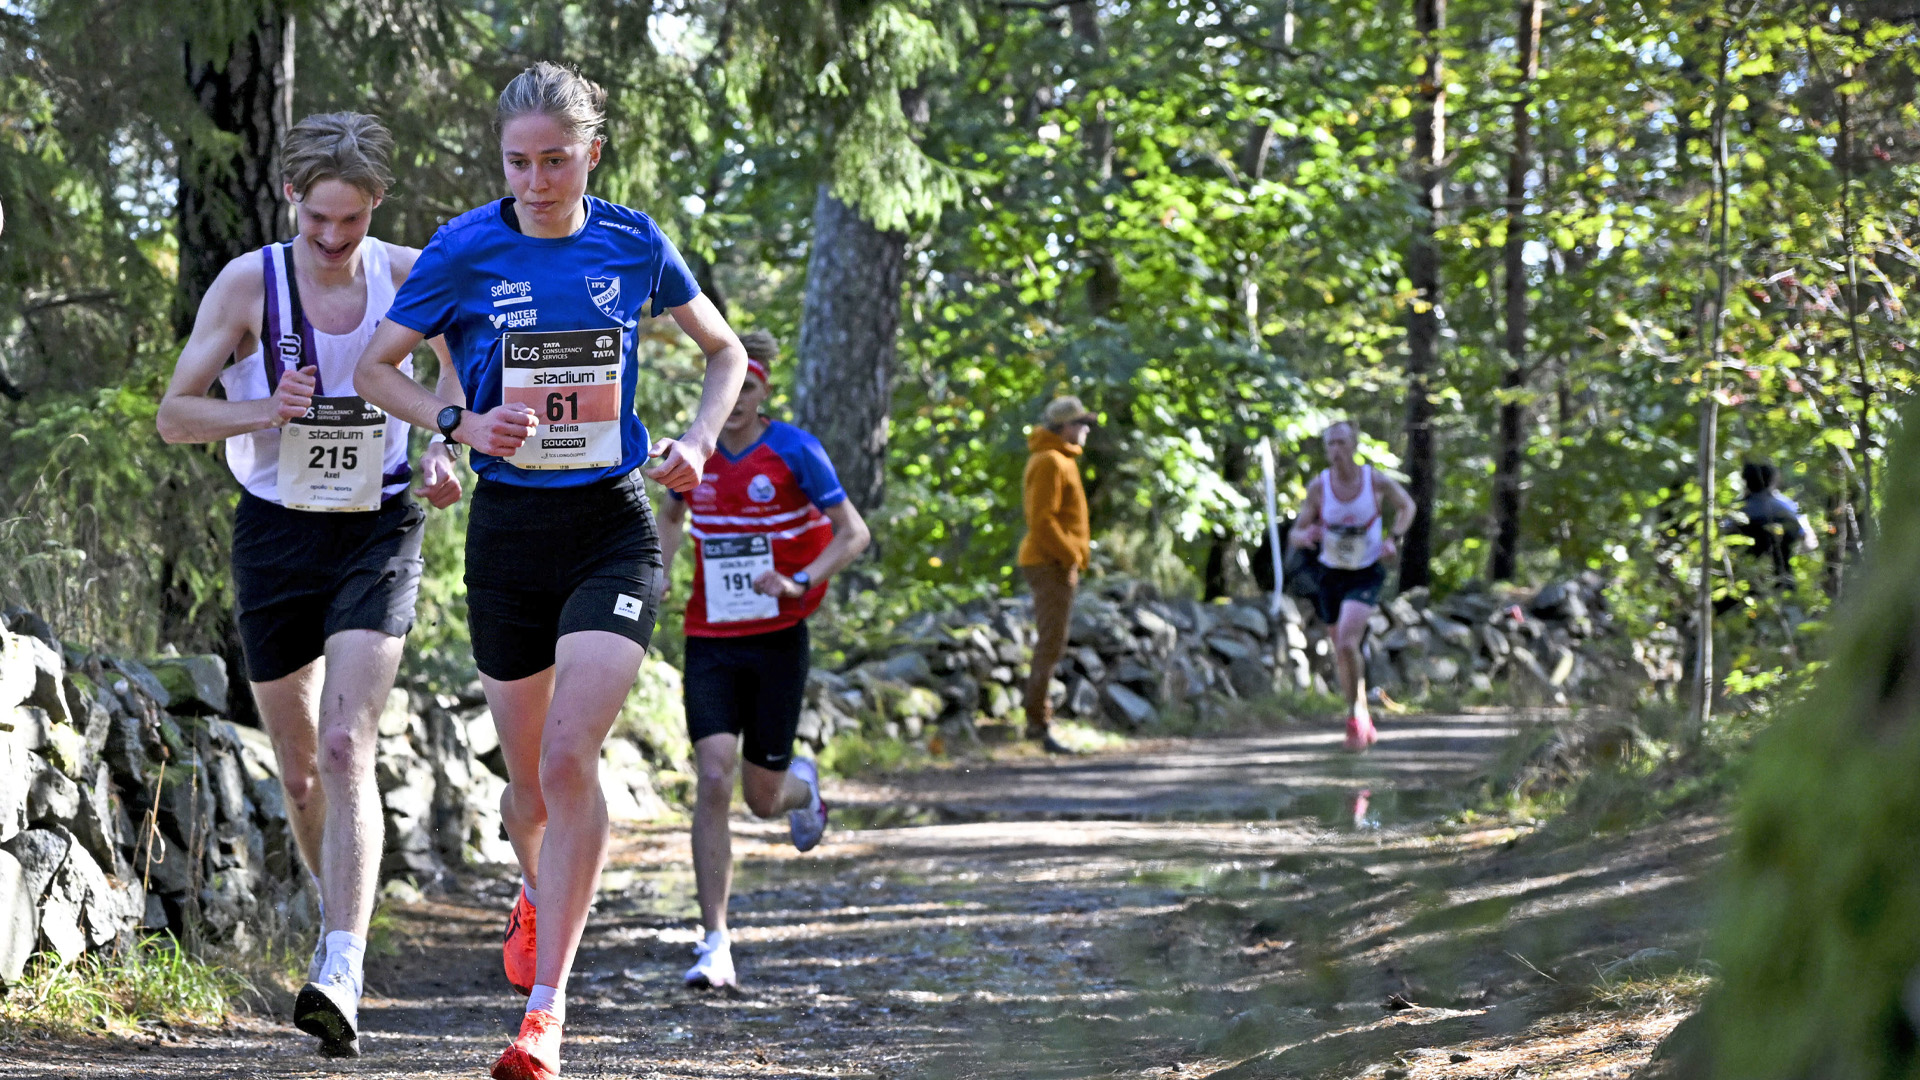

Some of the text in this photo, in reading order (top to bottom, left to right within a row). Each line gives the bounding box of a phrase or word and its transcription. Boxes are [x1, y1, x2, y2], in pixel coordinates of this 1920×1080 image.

[491, 280, 531, 296] selbergs
[597, 286, 617, 304] UMEÅ
[507, 309, 537, 320] INTER
[507, 317, 537, 328] SPORT
[511, 343, 540, 361] tcs
[542, 347, 583, 355] CONSULTANCY
[592, 350, 615, 358] TATA
[534, 371, 594, 384] stadium
[546, 392, 578, 422] 61
[549, 424, 579, 432] Evelina
[308, 429, 363, 440] stadium
[543, 438, 585, 447] saucony
[308, 446, 358, 470] 215
[324, 471, 340, 479] Axel
[723, 572, 752, 591] 191
